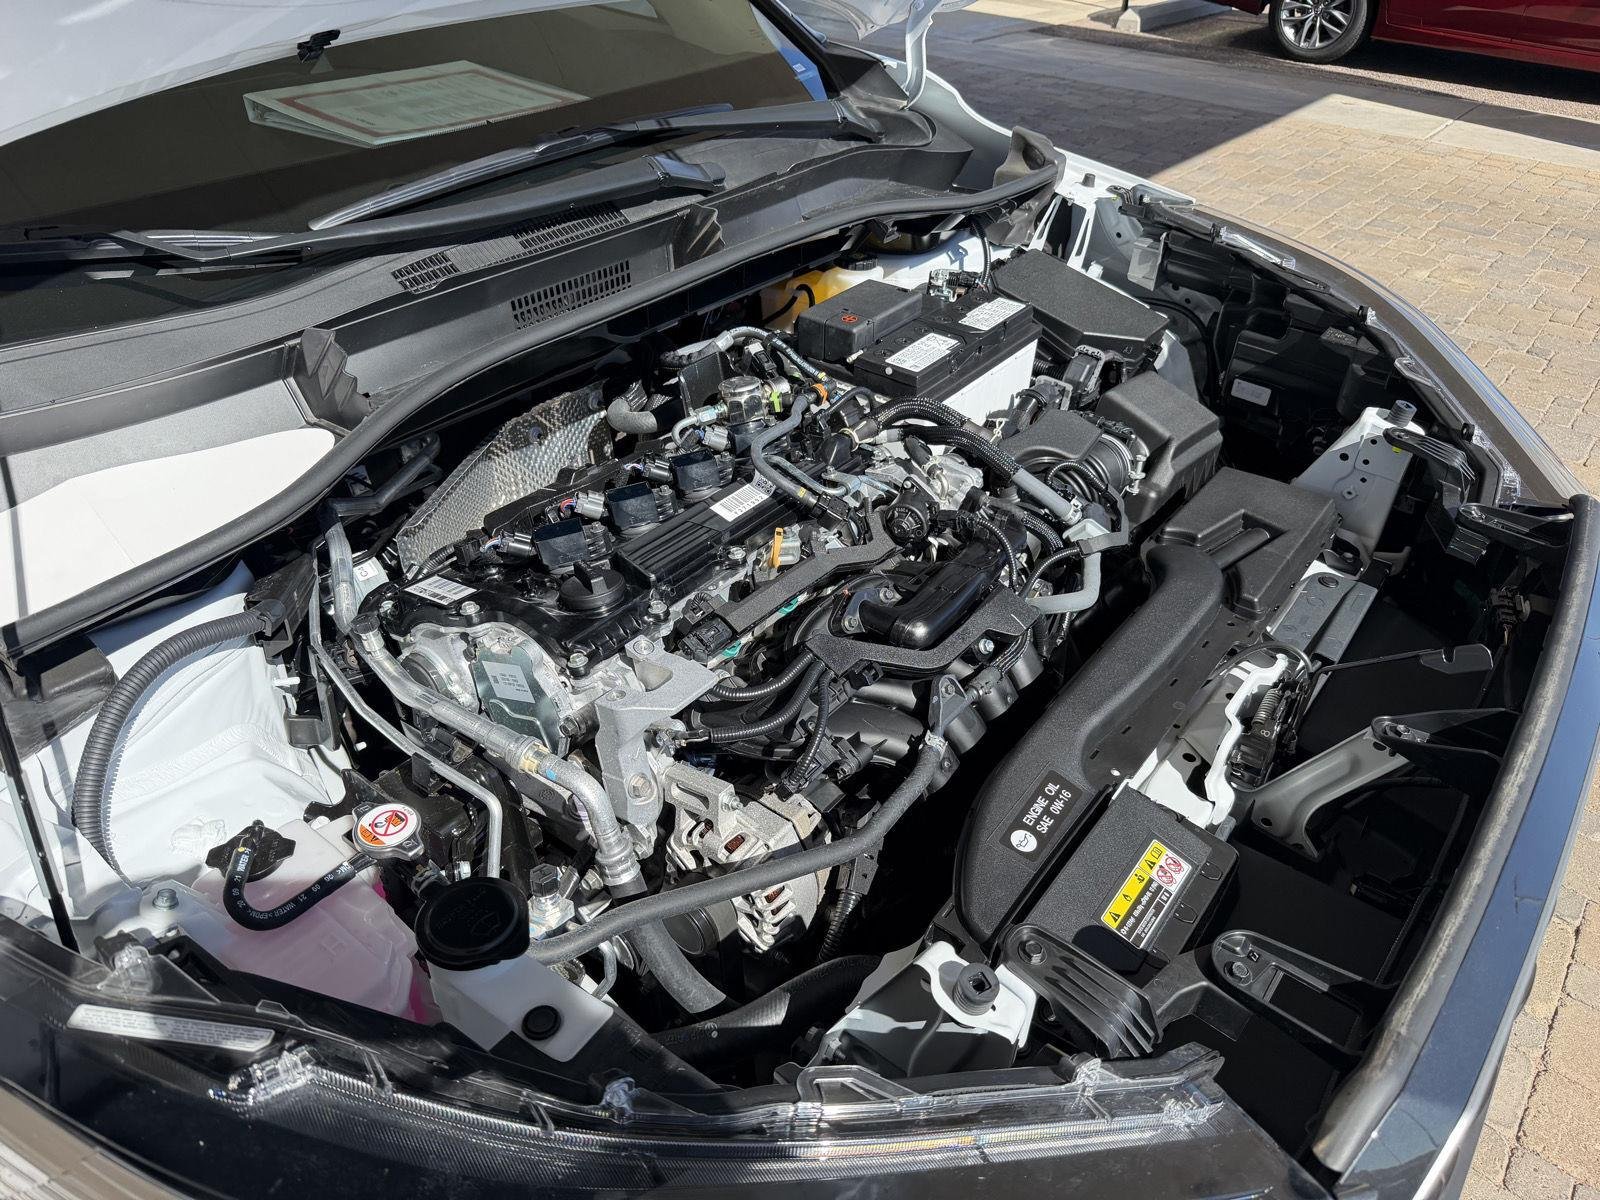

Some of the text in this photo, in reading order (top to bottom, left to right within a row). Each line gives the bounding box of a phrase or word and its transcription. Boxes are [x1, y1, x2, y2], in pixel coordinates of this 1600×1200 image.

[1022, 782, 1060, 826] ENGINE OIL
[1036, 789, 1072, 834] SAE 0W-16
[236, 854, 250, 872] WATER
[274, 902, 296, 917] WATER
